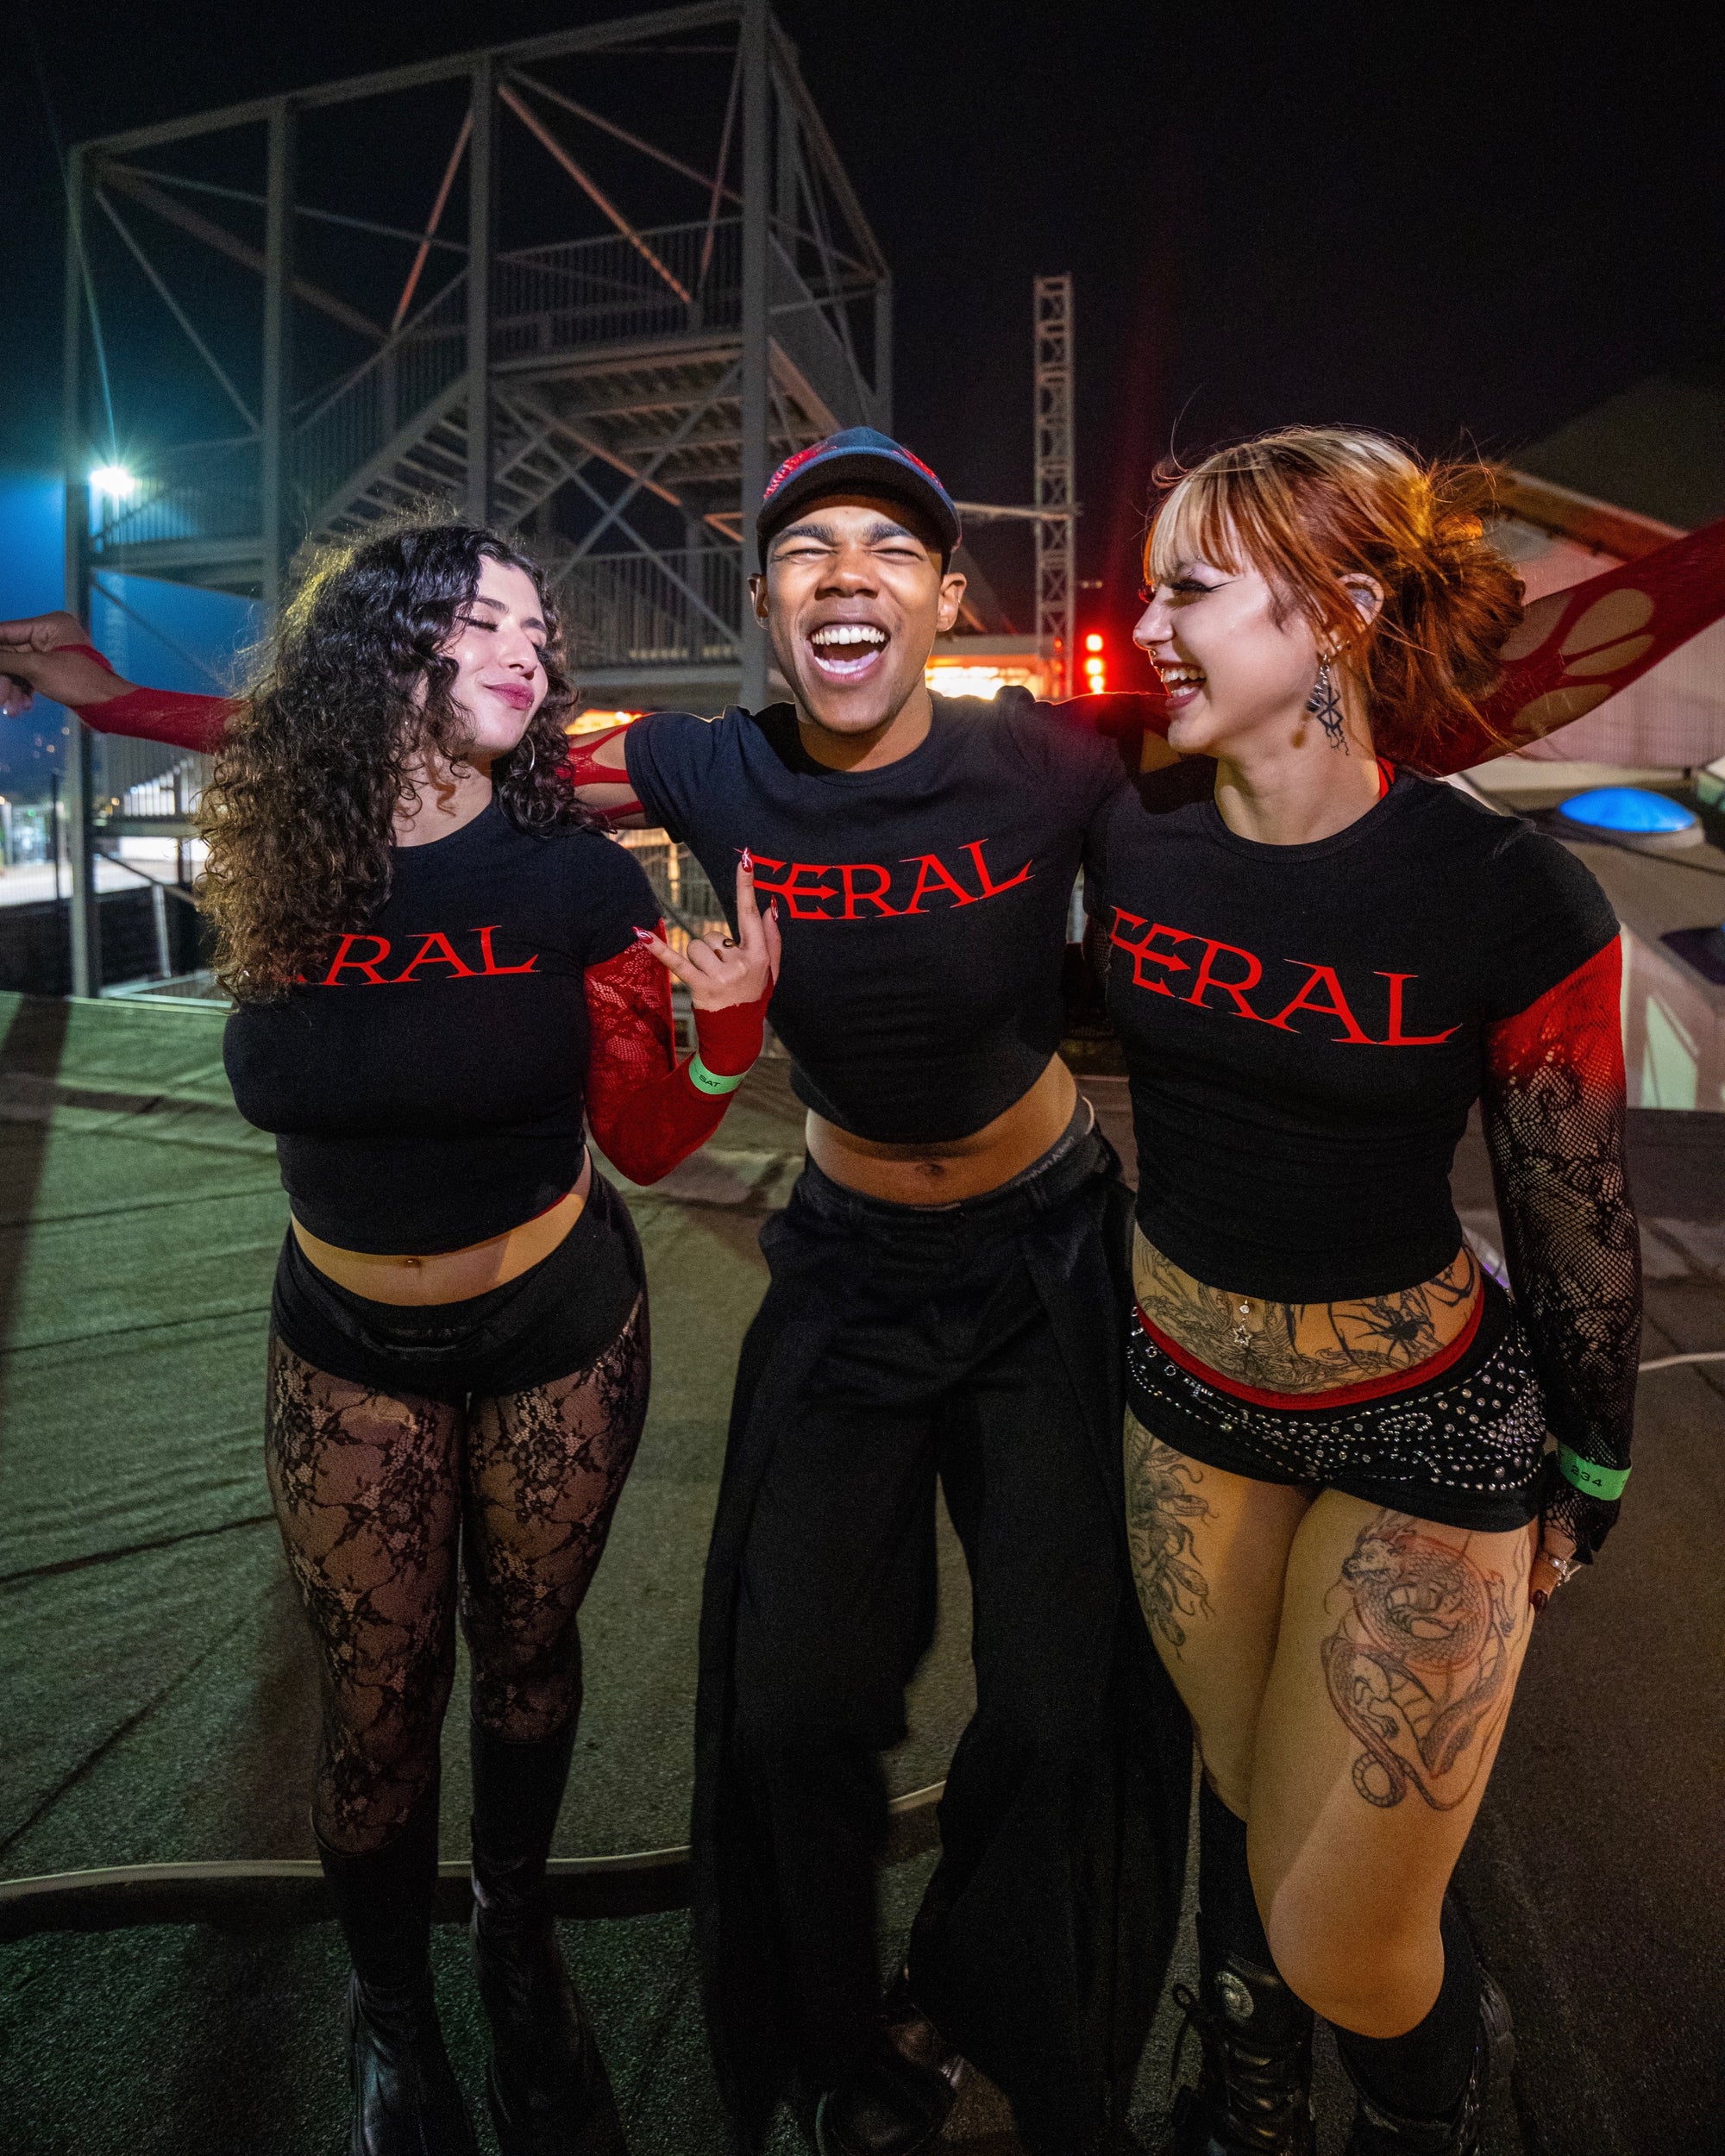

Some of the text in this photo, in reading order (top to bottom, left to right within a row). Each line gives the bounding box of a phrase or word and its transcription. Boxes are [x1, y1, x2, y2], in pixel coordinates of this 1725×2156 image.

[281, 925, 542, 986] RAL
[698, 1075, 721, 1087] SAT
[1571, 1464, 1603, 1488] 234
